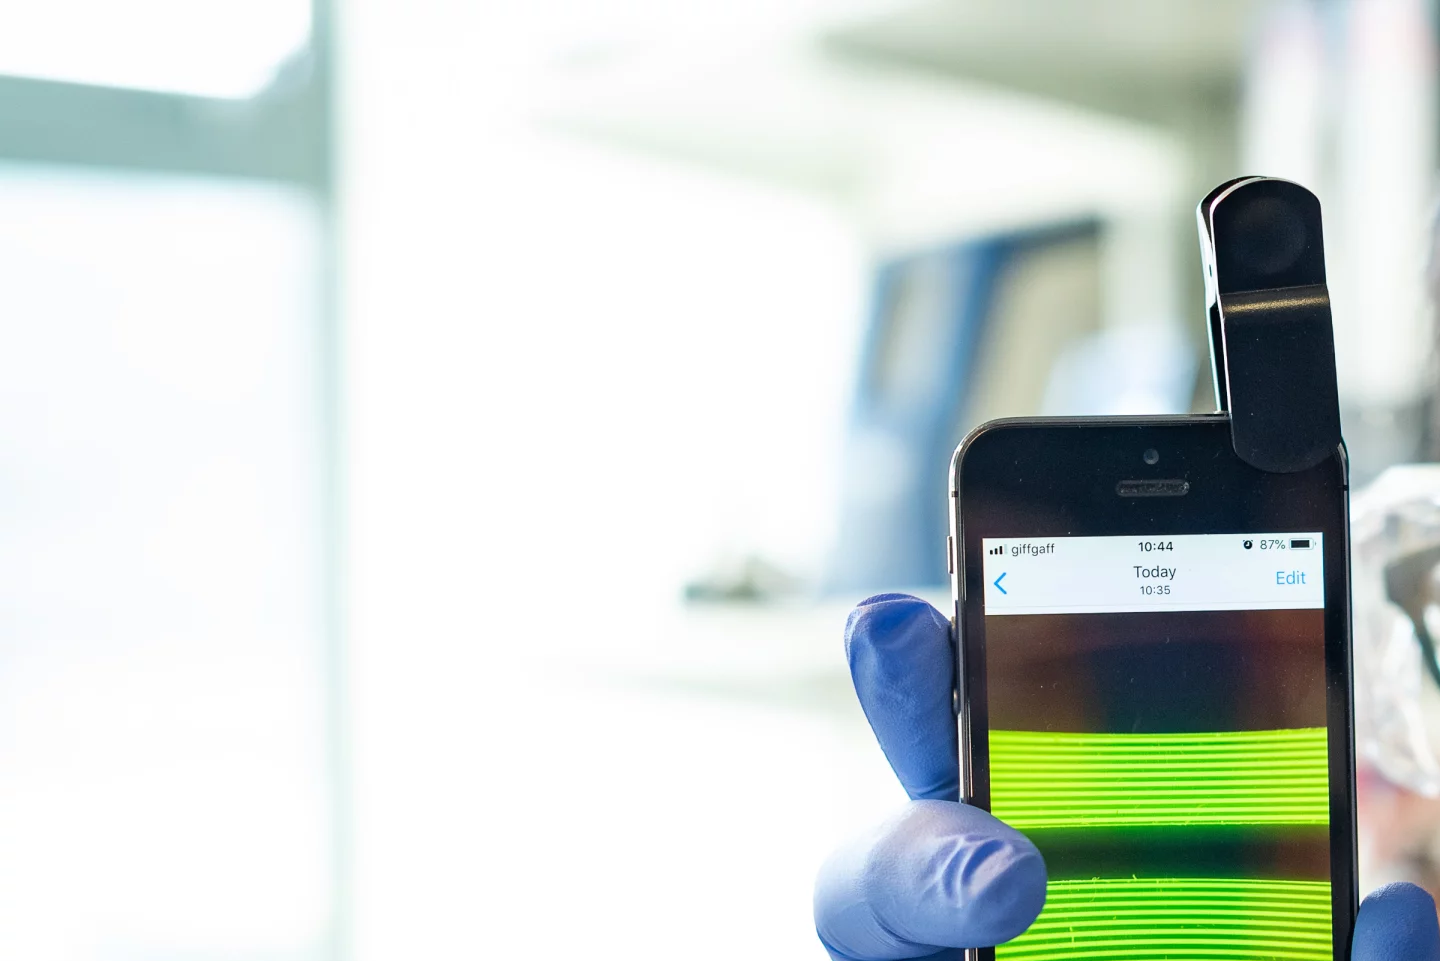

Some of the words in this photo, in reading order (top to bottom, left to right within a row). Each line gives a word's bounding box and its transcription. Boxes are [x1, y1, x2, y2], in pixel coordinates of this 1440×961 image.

[1011, 543, 1055, 557] giffgaff
[1138, 541, 1174, 552] 10:44
[1260, 539, 1286, 550] 87%
[1133, 565, 1177, 581] Today
[1276, 571, 1306, 585] Edit
[1139, 585, 1171, 596] 10:35
